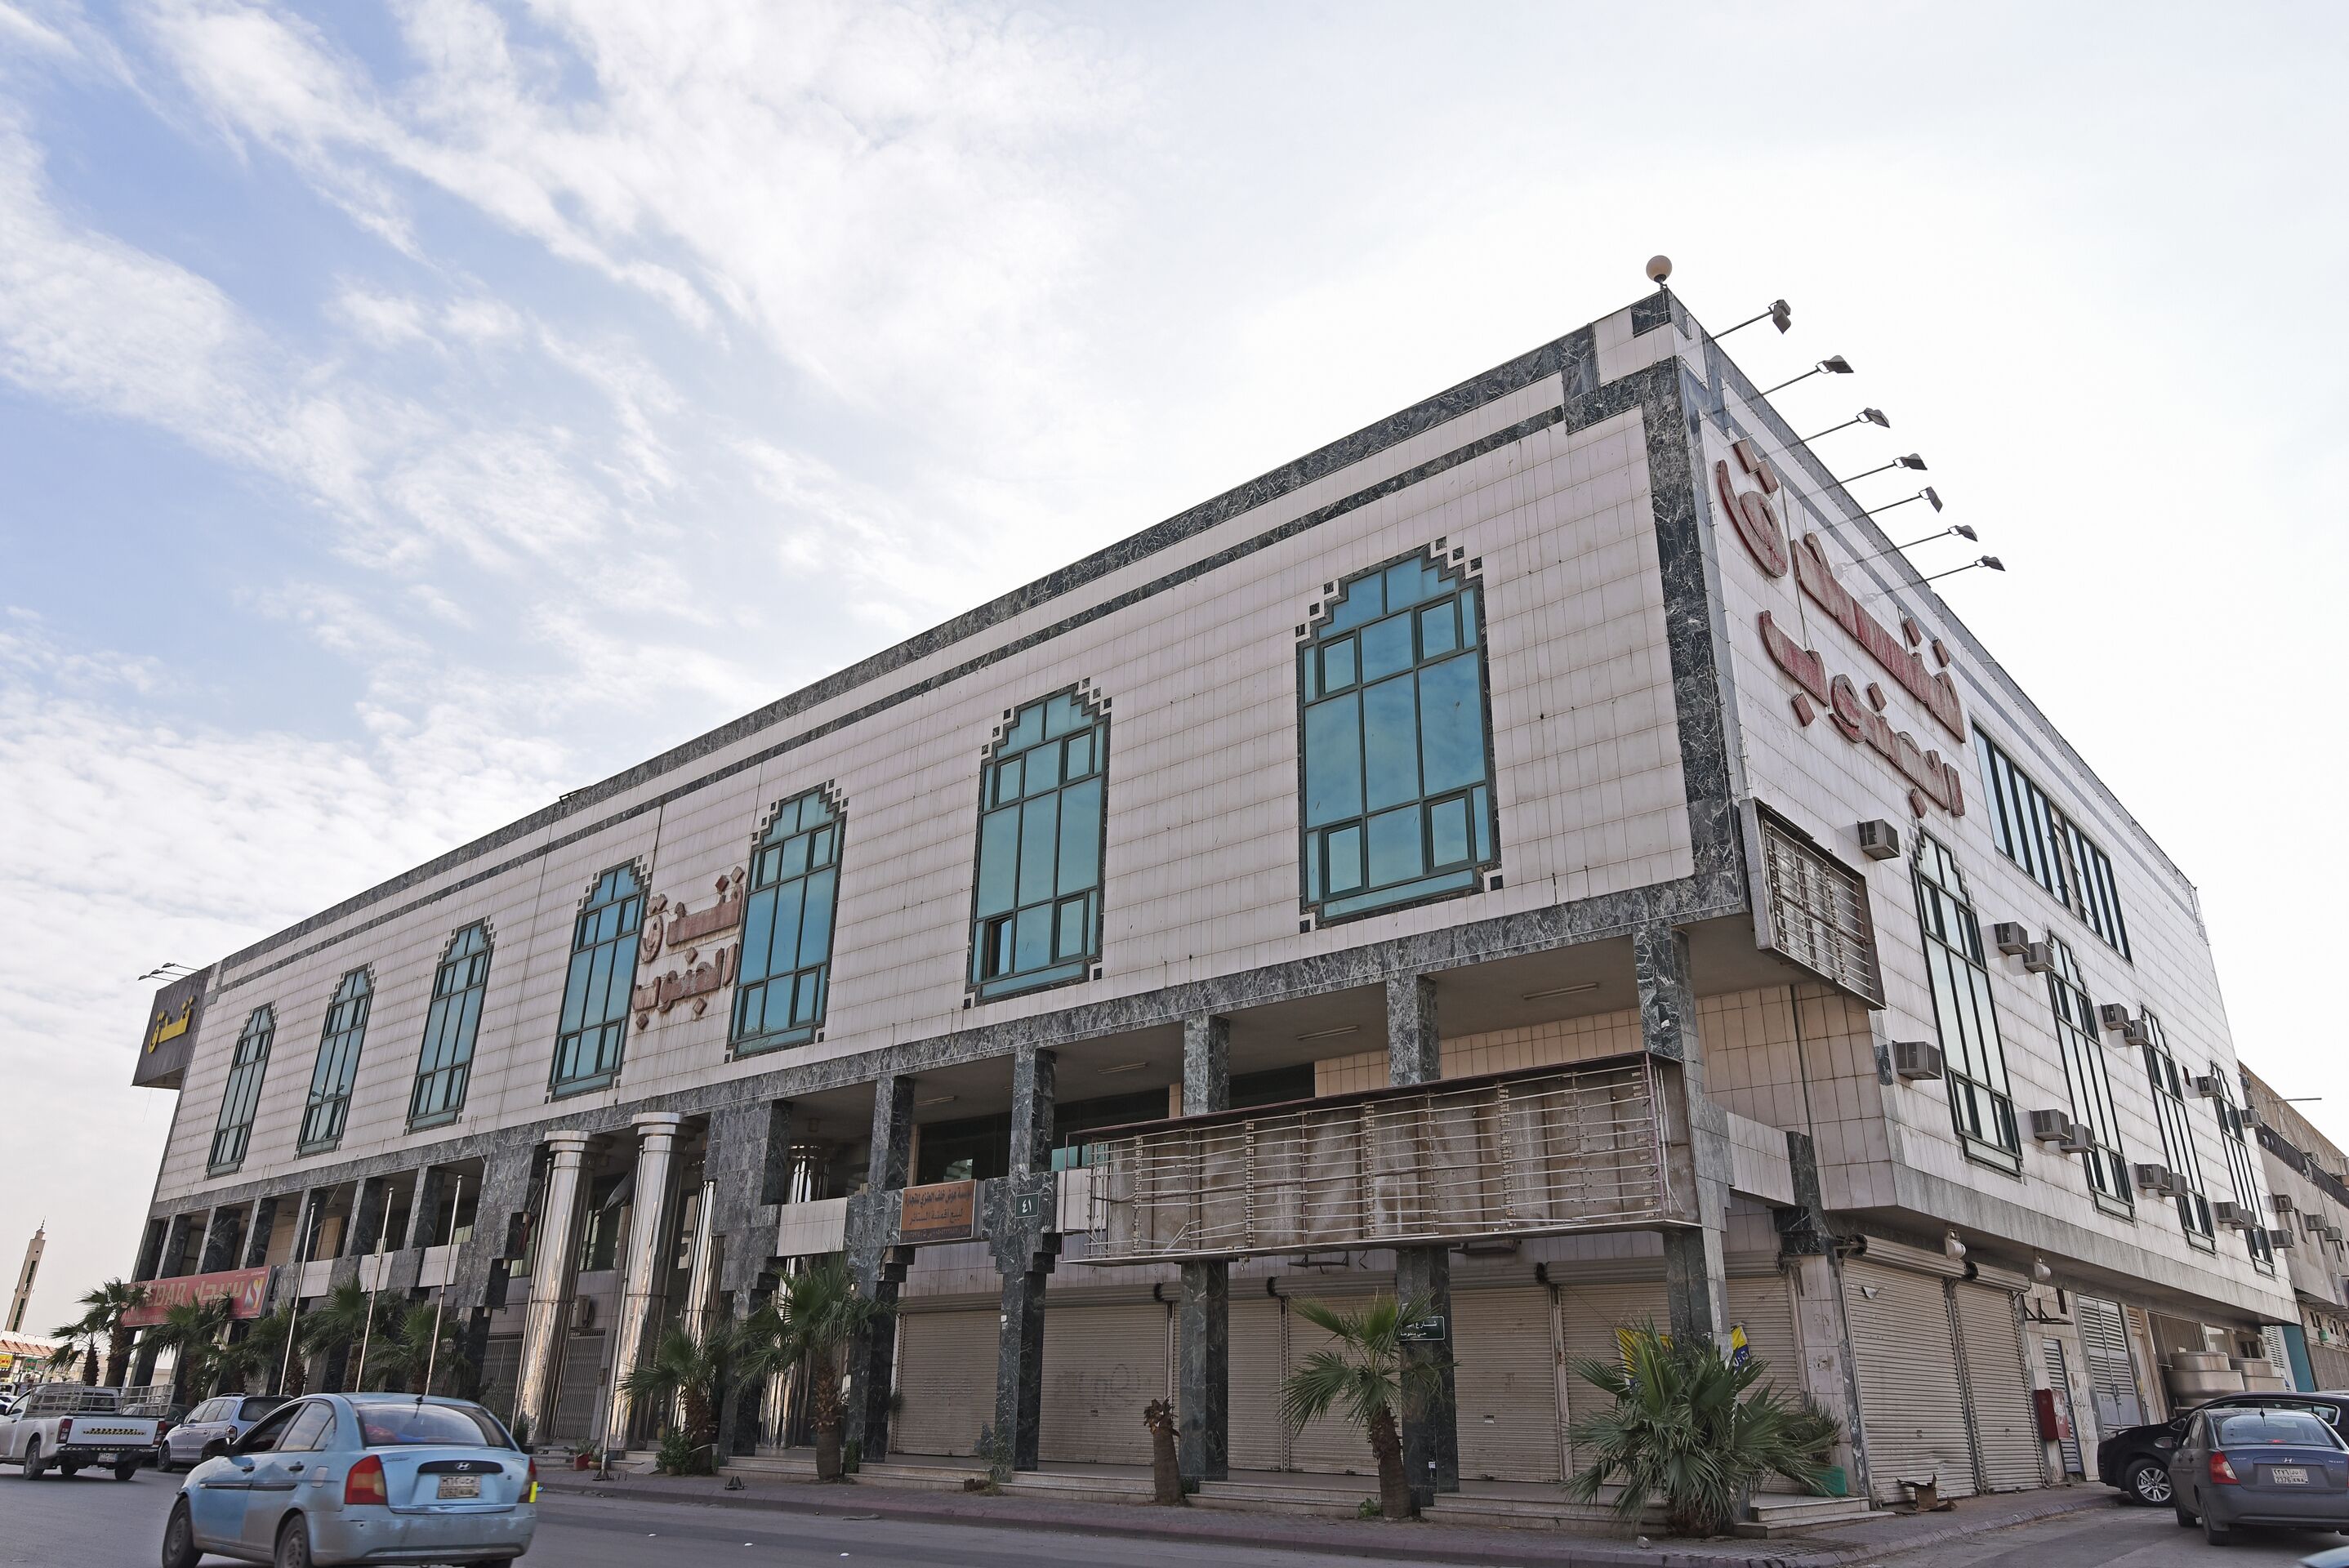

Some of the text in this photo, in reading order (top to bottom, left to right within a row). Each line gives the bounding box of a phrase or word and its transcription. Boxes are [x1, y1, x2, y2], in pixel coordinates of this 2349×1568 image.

[1717, 438, 1966, 743] فندق
[1758, 609, 1966, 818] الجنوب
[640, 866, 745, 963] فندق
[148, 996, 195, 1054] فندق
[632, 942, 738, 1030] الجنوب
[142, 1282, 187, 1307] EDAR
[1415, 1320, 1437, 1329] شارع
